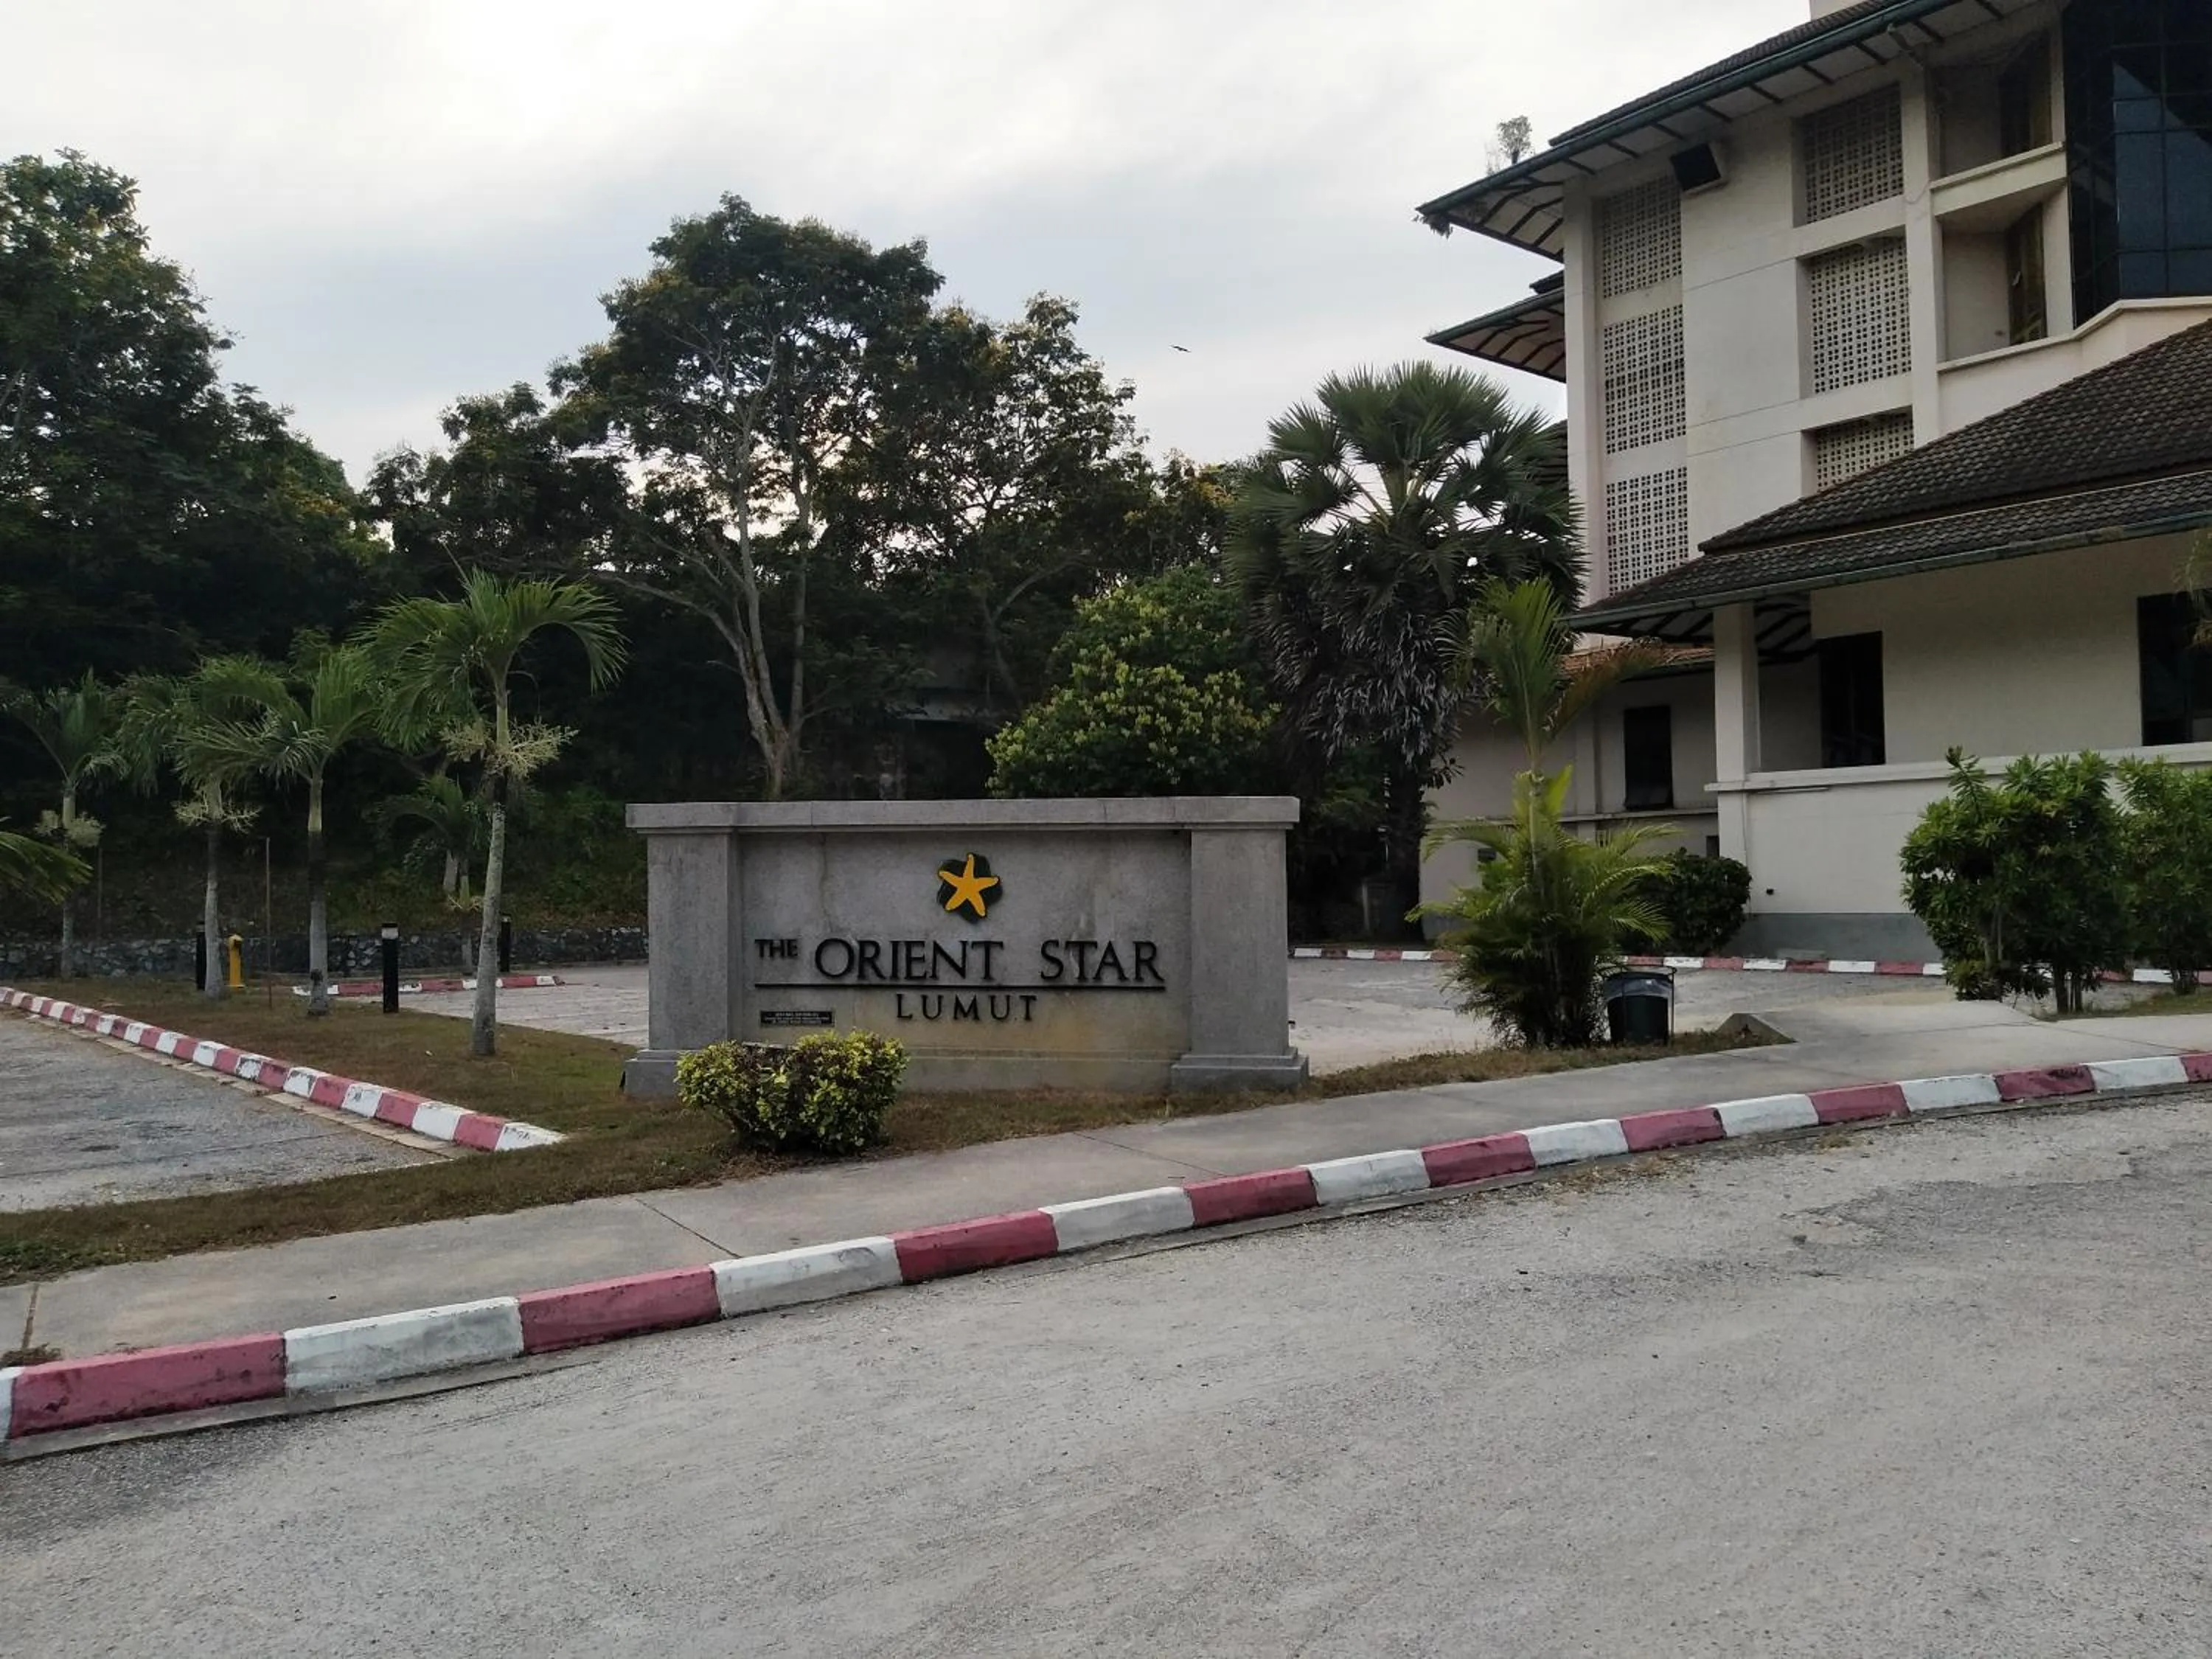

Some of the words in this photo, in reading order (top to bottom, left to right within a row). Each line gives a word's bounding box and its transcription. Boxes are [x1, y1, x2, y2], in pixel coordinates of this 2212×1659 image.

[754, 939, 798, 959] THE
[815, 938, 1004, 980] ORIENT
[1040, 940, 1165, 981] STAR
[896, 994, 1037, 1021] LUMUT
